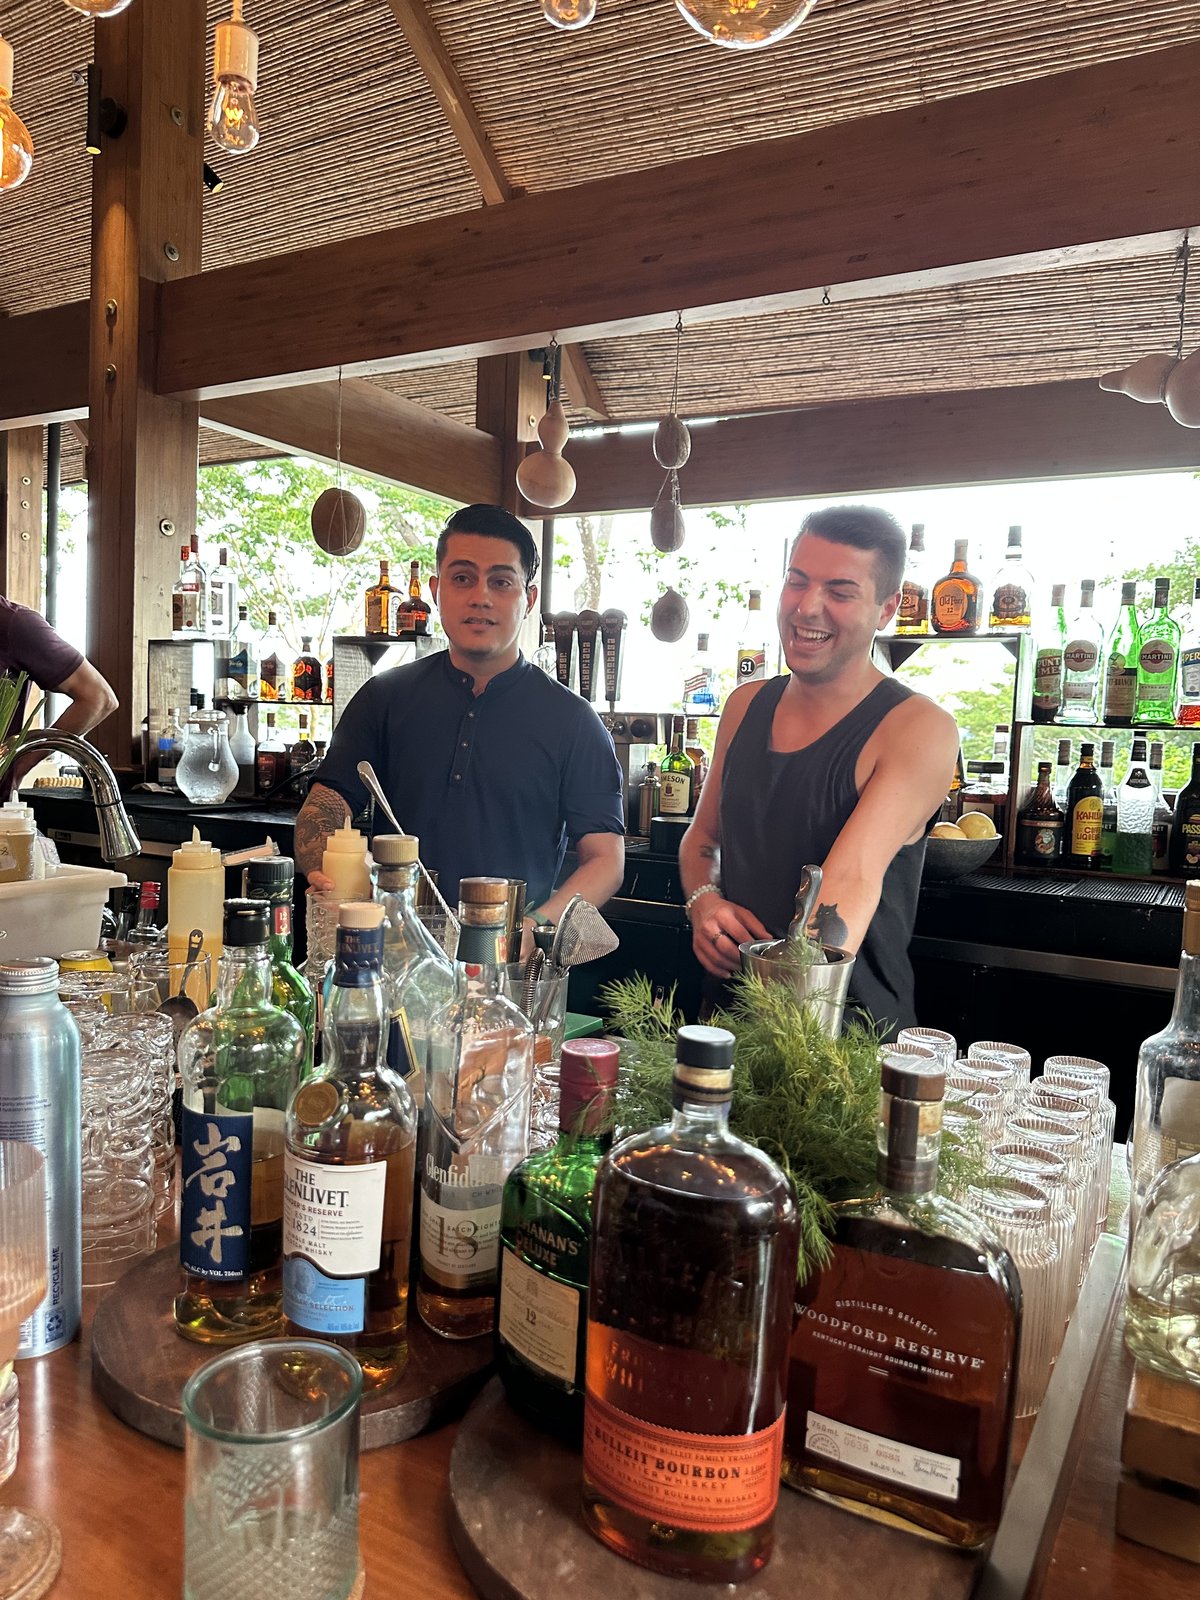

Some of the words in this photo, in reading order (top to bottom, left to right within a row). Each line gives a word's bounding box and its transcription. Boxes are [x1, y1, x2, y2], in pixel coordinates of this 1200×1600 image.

[741, 661, 753, 672] 51
[294, 1167, 316, 1186] THE
[185, 1122, 244, 1264] 岩井
[284, 1174, 350, 1208] LENLIVET
[307, 1205, 344, 1217] RESERVE
[292, 1218, 316, 1237] 1824
[308, 1239, 327, 1249] MALT
[436, 1215, 479, 1260] 18
[52, 1246, 60, 1262] ME
[305, 1245, 333, 1256] WHISKY
[52, 1263, 60, 1306] RECYCLE
[525, 1307, 537, 1326] 12
[835, 1299, 894, 1316] DISTILLER'S
[898, 1311, 937, 1336] SELECT
[793, 1302, 888, 1344] WOODFORD
[895, 1336, 985, 1370] RESERVE
[812, 1330, 847, 1347] KENTUCKY
[849, 1343, 883, 1359] STRAIGHT
[884, 1355, 919, 1370] BOURBON
[921, 1364, 954, 1379] WHISKEY
[595, 1425, 650, 1465] BULLEIT
[656, 1457, 740, 1480] BOURBON
[695, 1454, 725, 1462] FAMILY
[664, 1474, 727, 1489] WHISKEY
[664, 1489, 711, 1503] BOURBON
